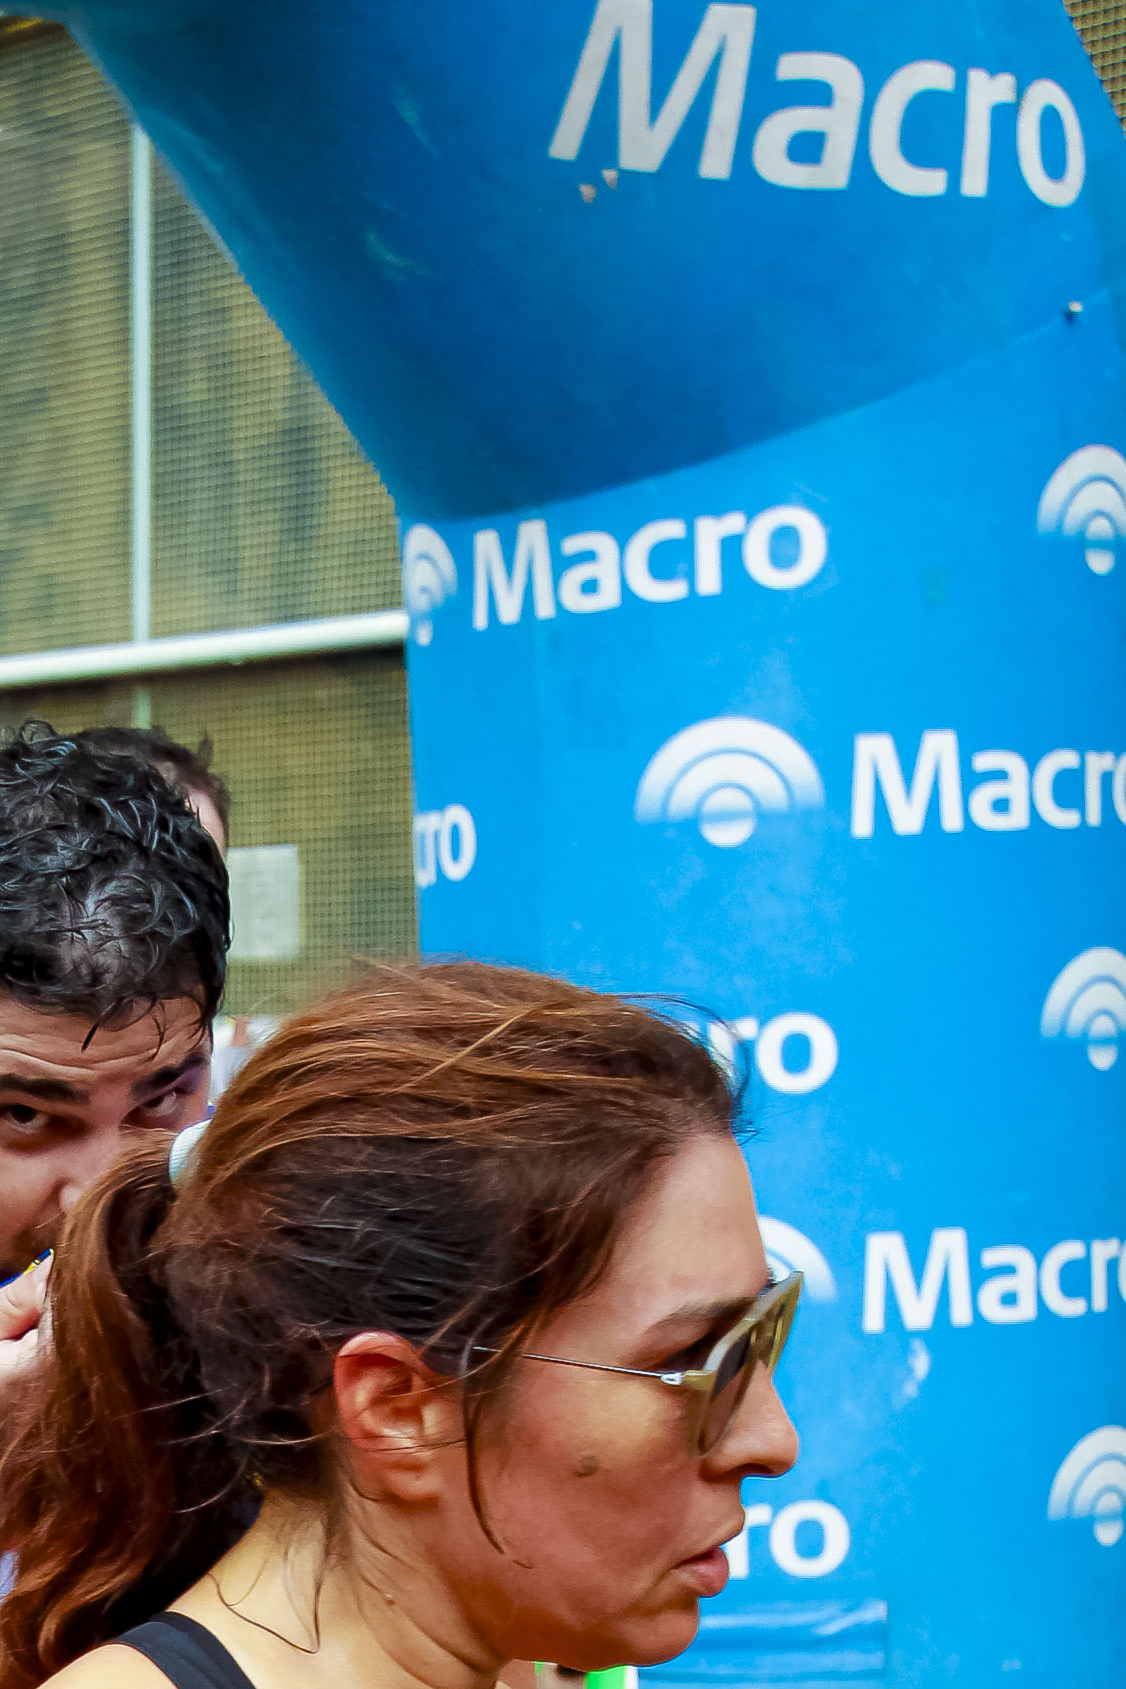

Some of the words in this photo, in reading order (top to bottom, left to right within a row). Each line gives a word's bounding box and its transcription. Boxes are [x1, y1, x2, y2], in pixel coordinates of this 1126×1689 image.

[548, 0, 1087, 208] Macro
[473, 505, 829, 631] Macro
[862, 1226, 1126, 1334] Macr
